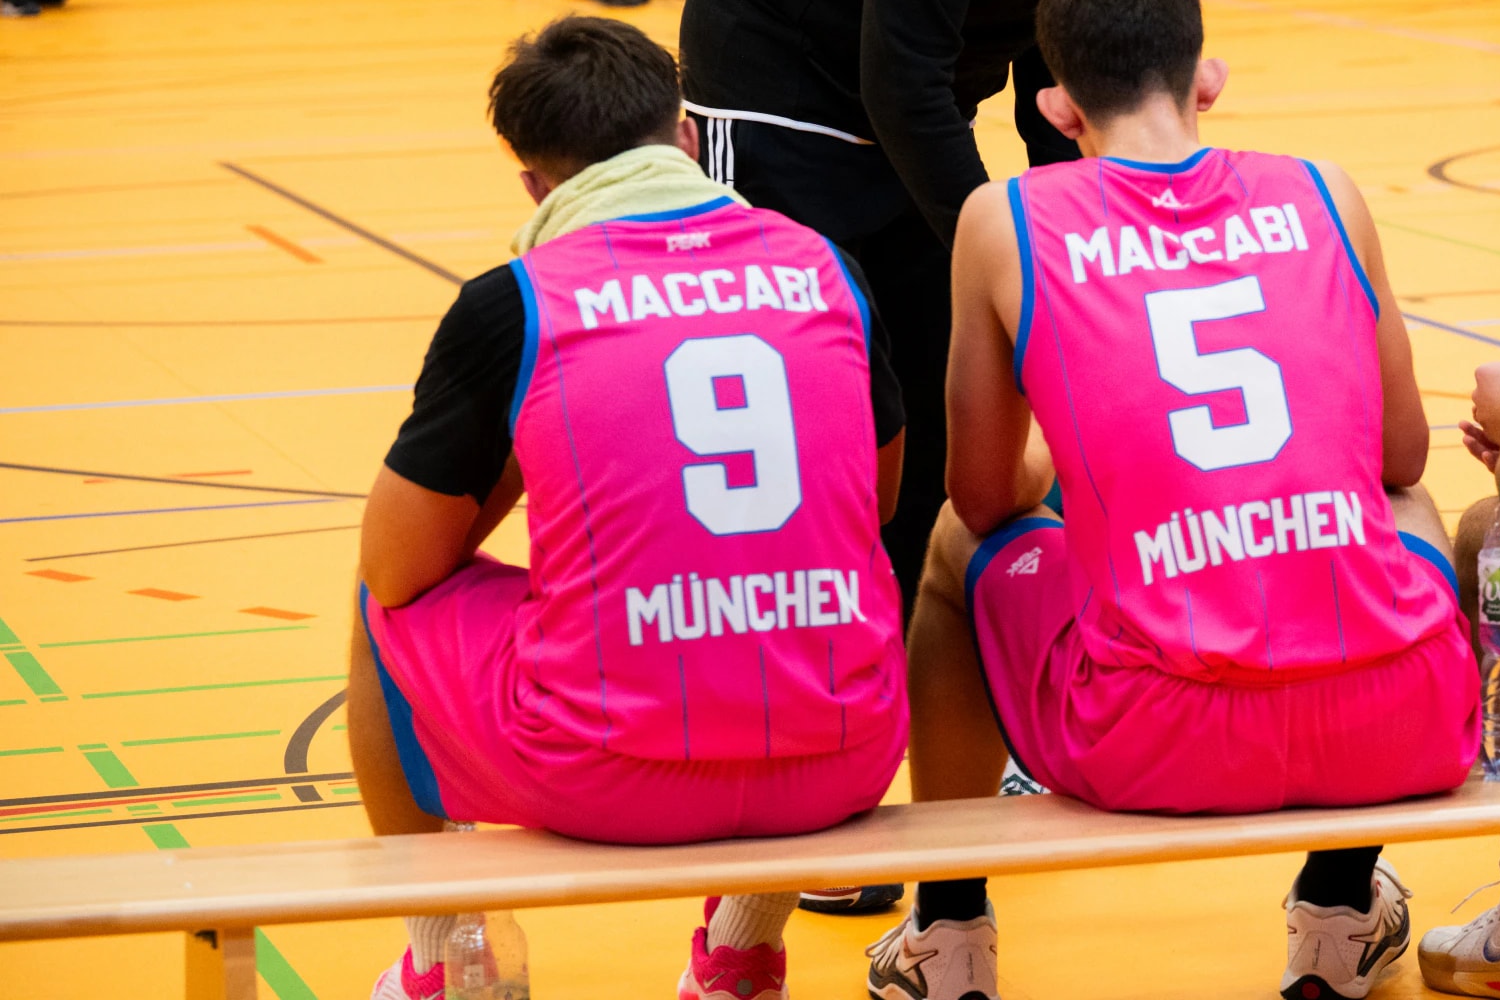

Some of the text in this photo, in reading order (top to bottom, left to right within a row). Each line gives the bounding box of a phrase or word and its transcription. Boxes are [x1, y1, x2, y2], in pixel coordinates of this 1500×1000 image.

[1064, 203, 1309, 284] MACCABI
[574, 264, 829, 330] MACCABI
[1144, 274, 1294, 473] 5
[664, 333, 803, 537] 9
[1133, 490, 1367, 586] MÜNCHEN
[625, 568, 867, 646] MÜNCHEN
